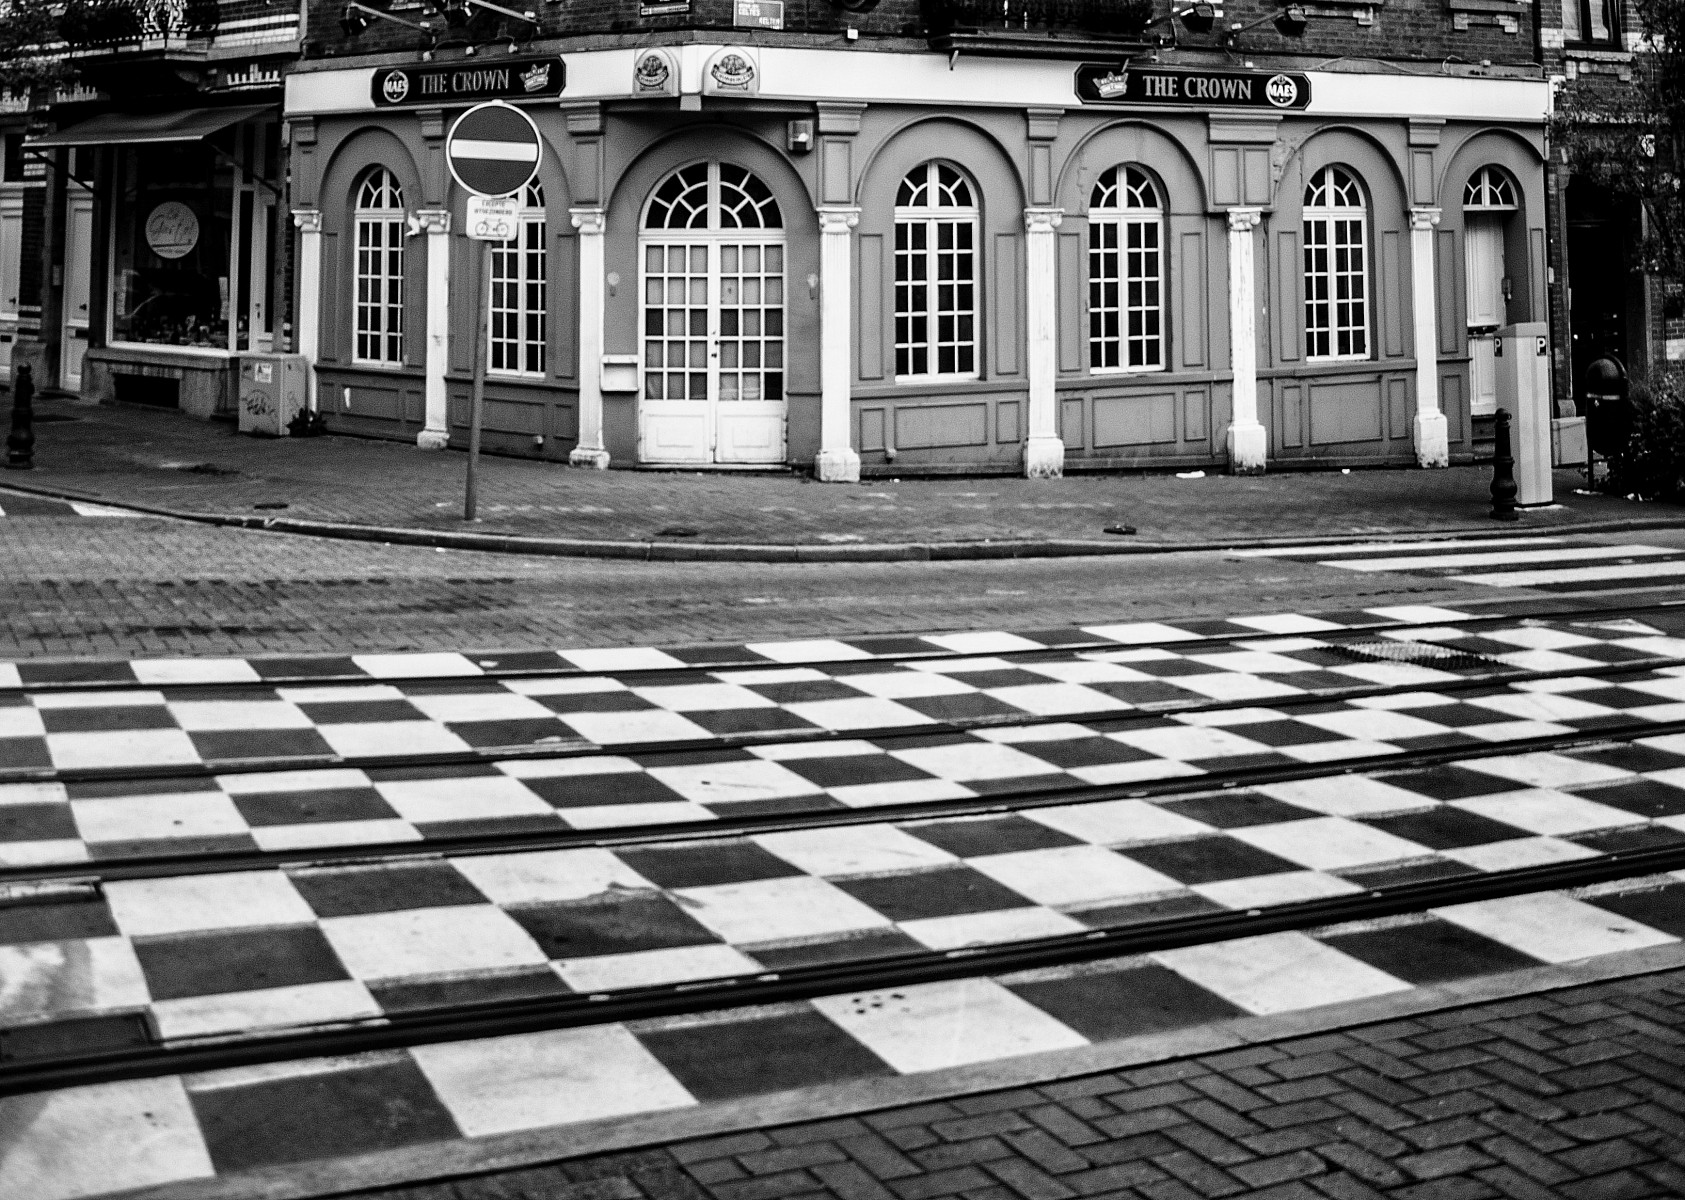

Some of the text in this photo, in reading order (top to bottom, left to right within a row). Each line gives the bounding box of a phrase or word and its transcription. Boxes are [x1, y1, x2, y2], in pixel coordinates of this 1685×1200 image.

[419, 68, 509, 94] THE CROWN
[1142, 75, 1252, 100] THE CROWN
[1268, 83, 1296, 98] MAES
[1494, 338, 1501, 353] P
[1536, 337, 1546, 353] P
